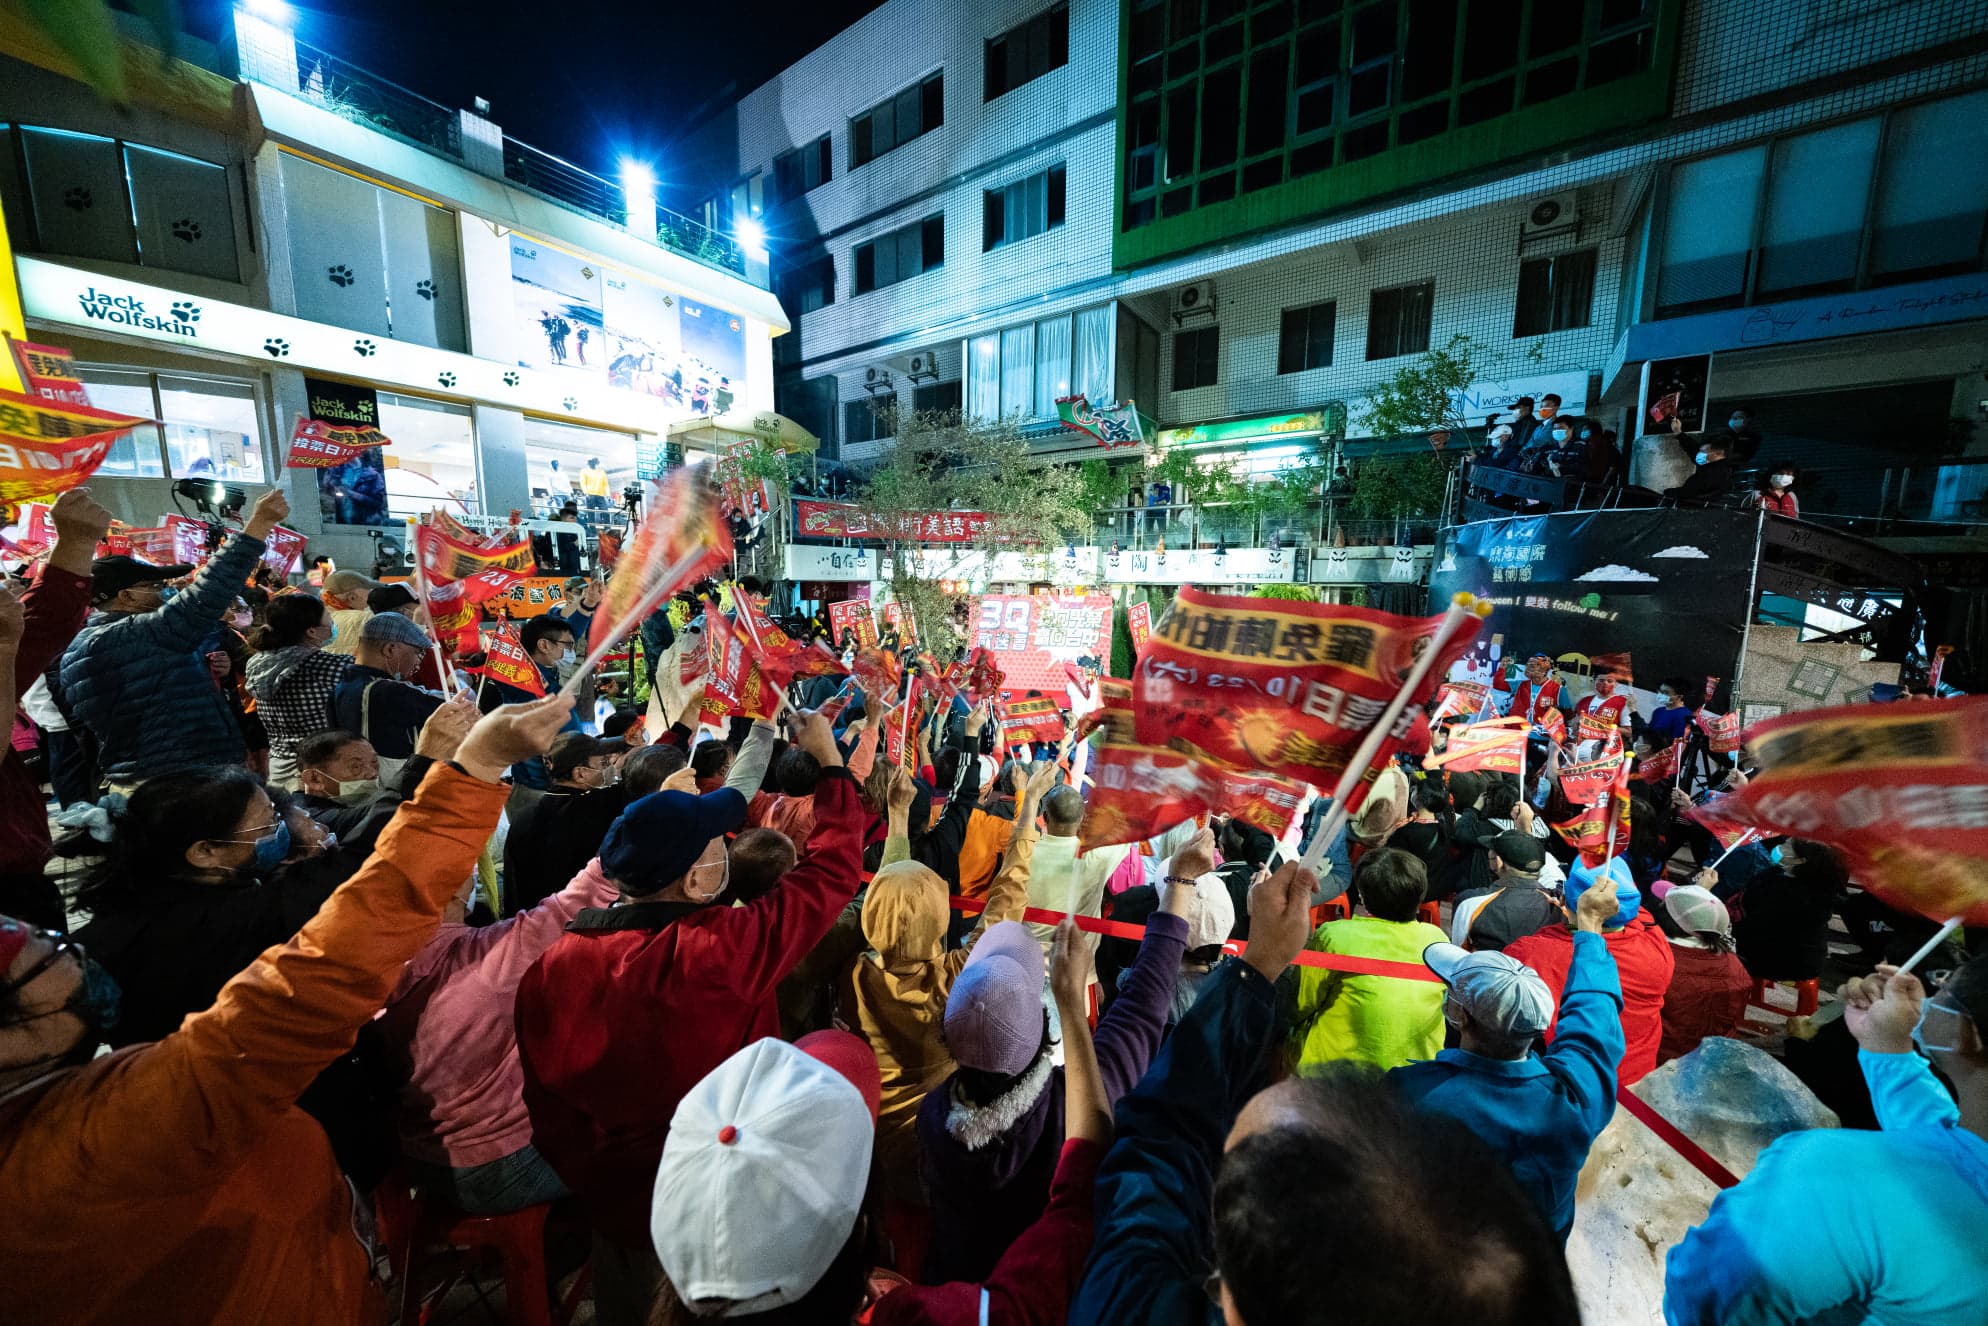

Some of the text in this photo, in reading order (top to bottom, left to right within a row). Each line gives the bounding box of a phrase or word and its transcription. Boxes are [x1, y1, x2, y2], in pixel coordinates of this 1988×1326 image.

[78, 287, 146, 313] Jack
[79, 300, 197, 337] Wolfskin
[312, 396, 345, 410] Jack
[312, 405, 372, 422] Wolfskin
[293, 437, 340, 455] 投票日
[497, 583, 562, 604] 海藝術
[978, 600, 1031, 633] 3Q
[1552, 599, 1588, 614] follow
[491, 637, 523, 661] 投票日
